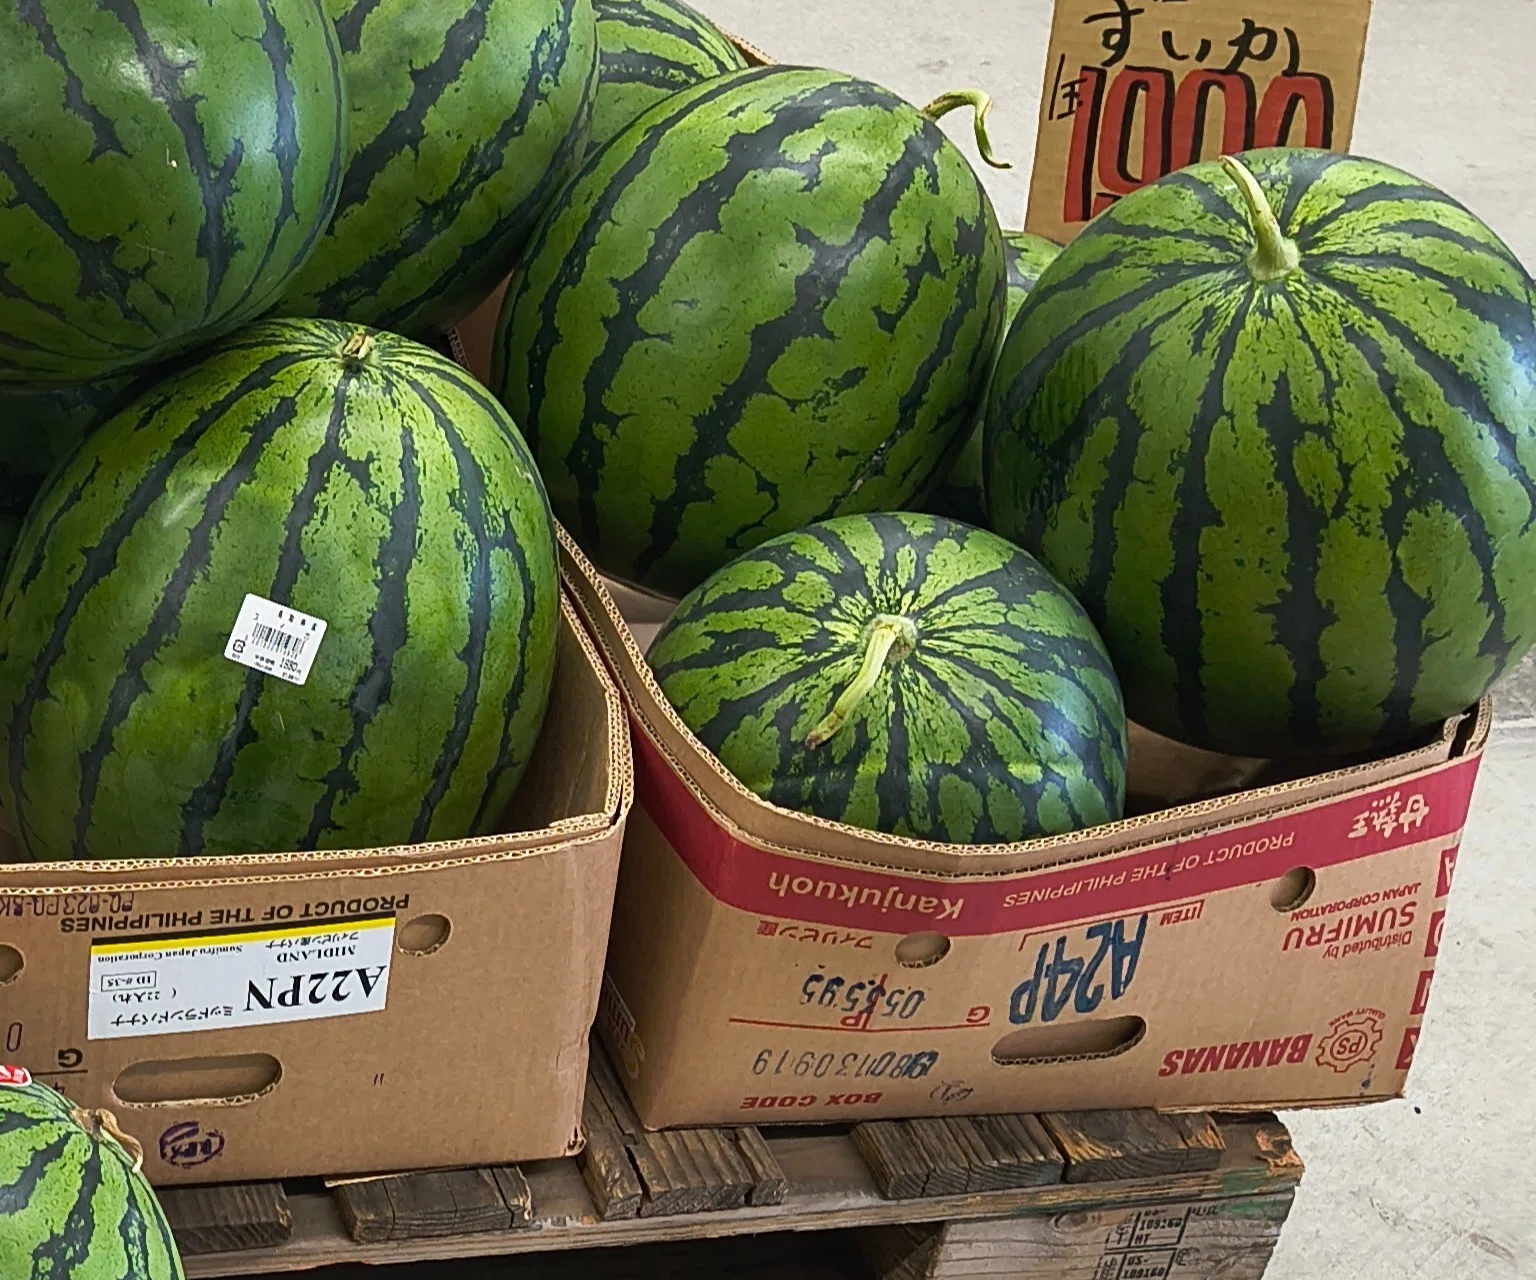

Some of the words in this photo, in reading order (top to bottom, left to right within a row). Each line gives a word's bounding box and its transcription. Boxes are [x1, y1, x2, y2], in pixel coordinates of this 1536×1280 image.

[1203, 831, 1295, 866] PRODUCT
[1132, 862, 1167, 888] THE
[1173, 856, 1200, 874] OF
[768, 872, 964, 920] Kanjukuoh
[1003, 868, 1127, 908] PHILIPPINES
[1382, 882, 1421, 902] JAPAN
[261, 905, 293, 920] OF
[299, 894, 409, 919] PRODUCT
[1159, 905, 1197, 926] ITEM
[1290, 892, 1381, 922] CORPORATION
[60, 912, 202, 934] PHILIPPINES
[209, 909, 254, 926] THE
[1282, 902, 1417, 951] SUMIFRU
[266, 932, 359, 950] フィリピン産バナナ
[756, 920, 874, 950] フィリピン産
[1344, 929, 1413, 957] Distributed
[97, 951, 162, 964] Corporation
[164, 948, 198, 959] Japan
[199, 945, 243, 956] Sumifru
[276, 945, 356, 964] MIDLAND
[1322, 943, 1339, 959] by
[1009, 912, 1147, 1025] A24P
[243, 965, 387, 1012] A22PN
[110, 1006, 233, 1027] ミッドランドバナナ
[840, 1011, 863, 1028] P
[966, 1007, 992, 1025] G
[1158, 1033, 1313, 1078] BANANAS
[1337, 1037, 1363, 1056] PS
[58, 1049, 83, 1069] G
[738, 1094, 817, 1109] CODE
[822, 1092, 882, 1107] BOX
